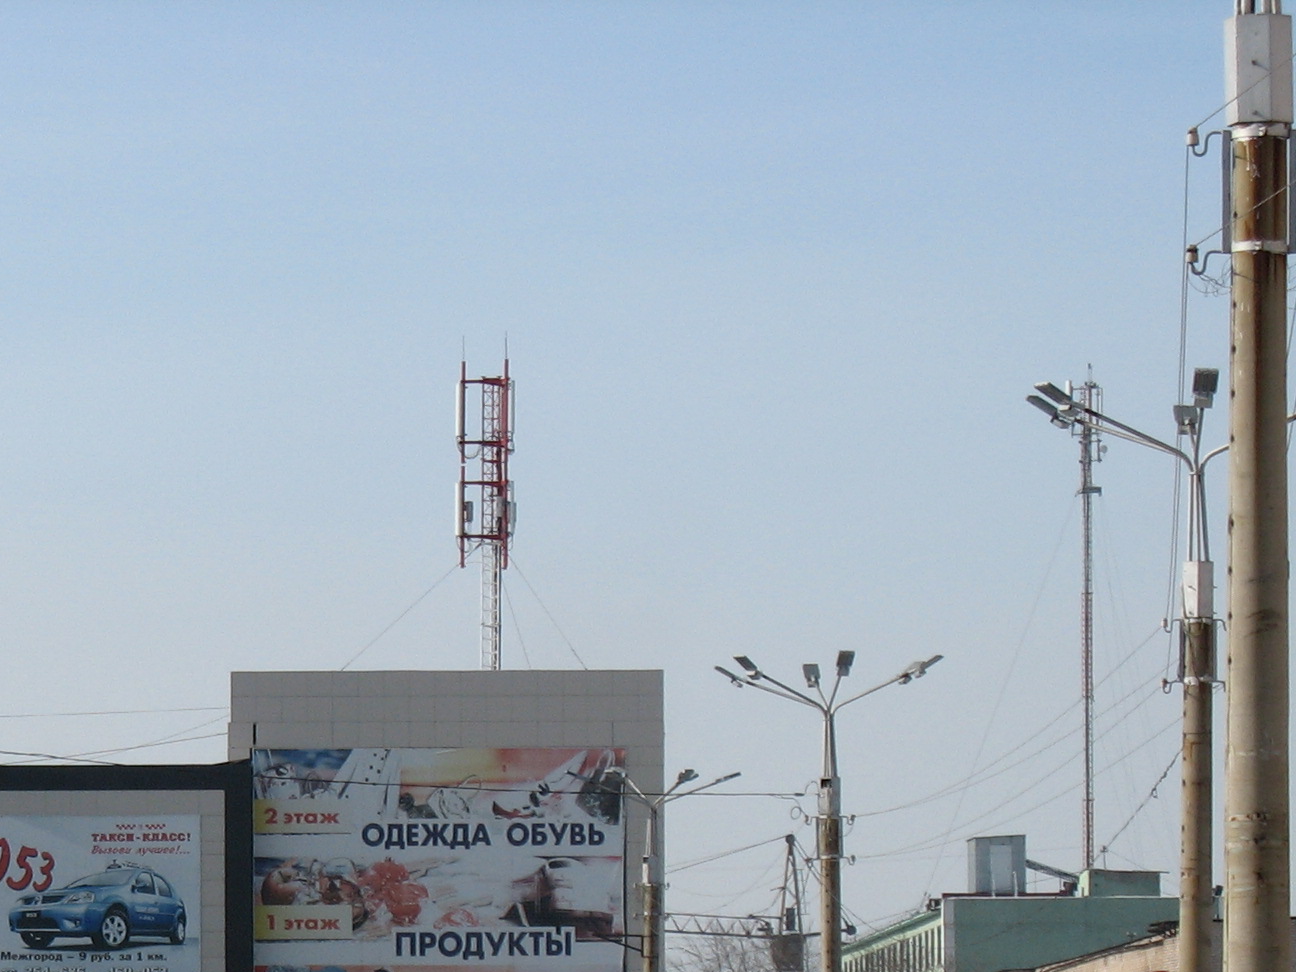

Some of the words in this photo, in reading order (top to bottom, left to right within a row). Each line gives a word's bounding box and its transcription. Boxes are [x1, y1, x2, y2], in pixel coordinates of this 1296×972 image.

[263, 809, 278, 824] 2
[282, 811, 340, 825] этаж
[361, 822, 492, 850] ОДЕЖДА
[506, 822, 606, 847] ОБУВЬ
[90, 845, 131, 855] Вызови
[266, 917, 276, 930] 1
[284, 918, 340, 931] этаж
[395, 930, 574, 960] ПРОДУКТЫ
[0, 951, 63, 963] Межгород
[78, 951, 86, 961] 9
[90, 952, 115, 963] руб.
[119, 953, 132, 961] за
[148, 953, 168, 962] км.
